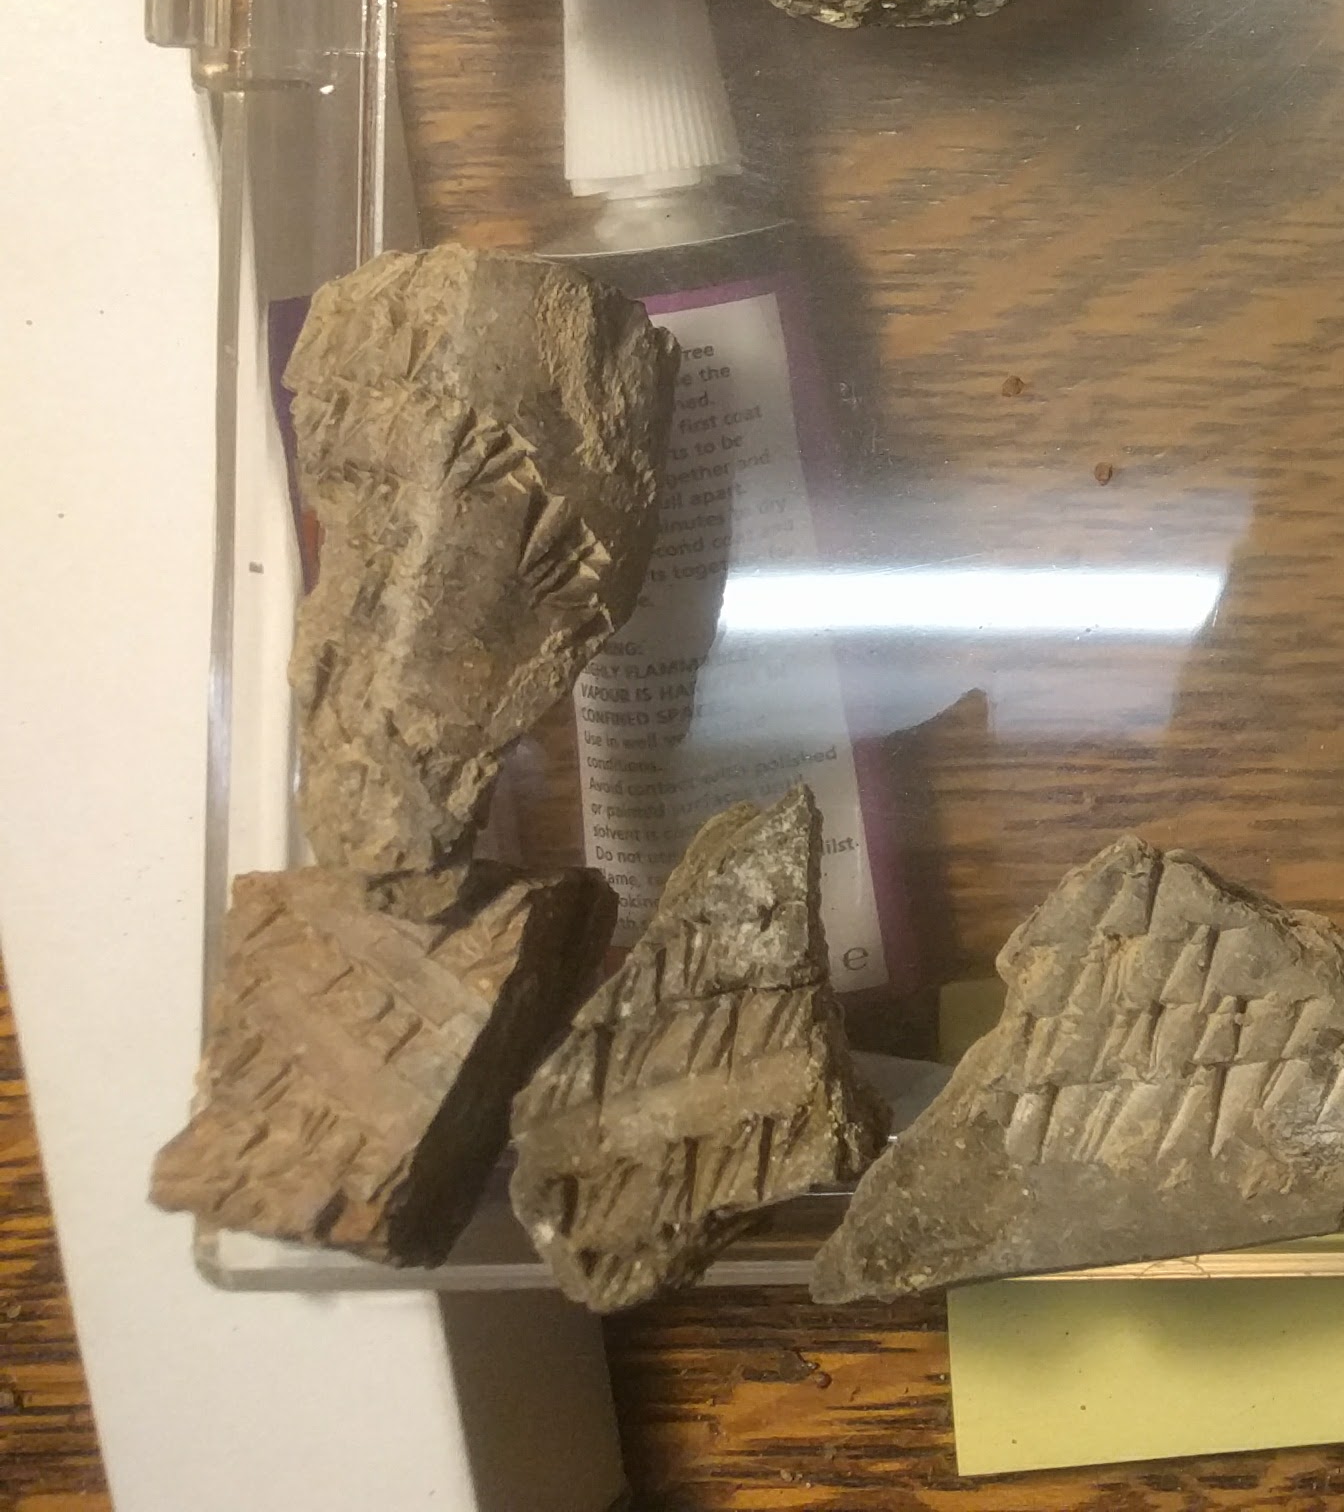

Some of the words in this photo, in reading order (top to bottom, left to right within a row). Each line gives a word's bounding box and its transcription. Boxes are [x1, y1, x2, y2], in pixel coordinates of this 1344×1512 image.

[681, 345, 715, 360] ree
[698, 365, 731, 382] the
[679, 414, 717, 434] first
[724, 405, 762, 425] coat
[694, 441, 716, 457] to
[721, 434, 743, 450] be
[589, 776, 623, 796] Avoid
[593, 823, 641, 842] solvent
[595, 845, 613, 862] Do
[617, 851, 644, 865] not
